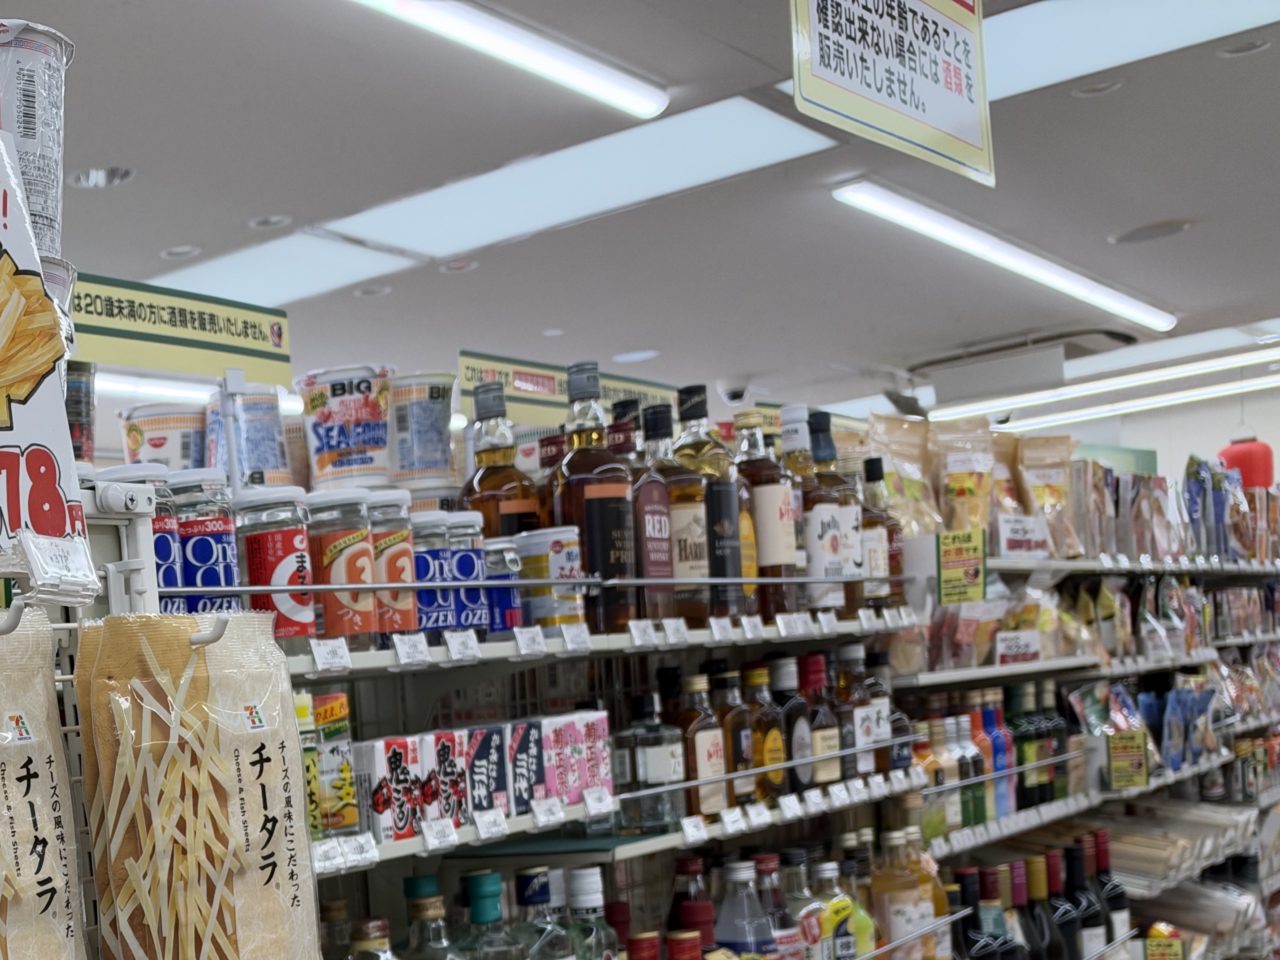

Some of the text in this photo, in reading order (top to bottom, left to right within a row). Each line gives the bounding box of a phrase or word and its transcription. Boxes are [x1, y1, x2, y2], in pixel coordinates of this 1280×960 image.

[819, 32, 926, 114] 販売いたしません。
[645, 513, 670, 539] RED
[0, 761, 9, 800] Cheese
[233, 748, 242, 784] Cheese
[241, 819, 250, 853] Sheets
[249, 742, 279, 886] チータラ
[9, 816, 17, 837] Fish
[11, 840, 22, 878] Sheets
[15, 755, 59, 915] チータラ
[278, 740, 301, 908] チーズの風味にこだわった
